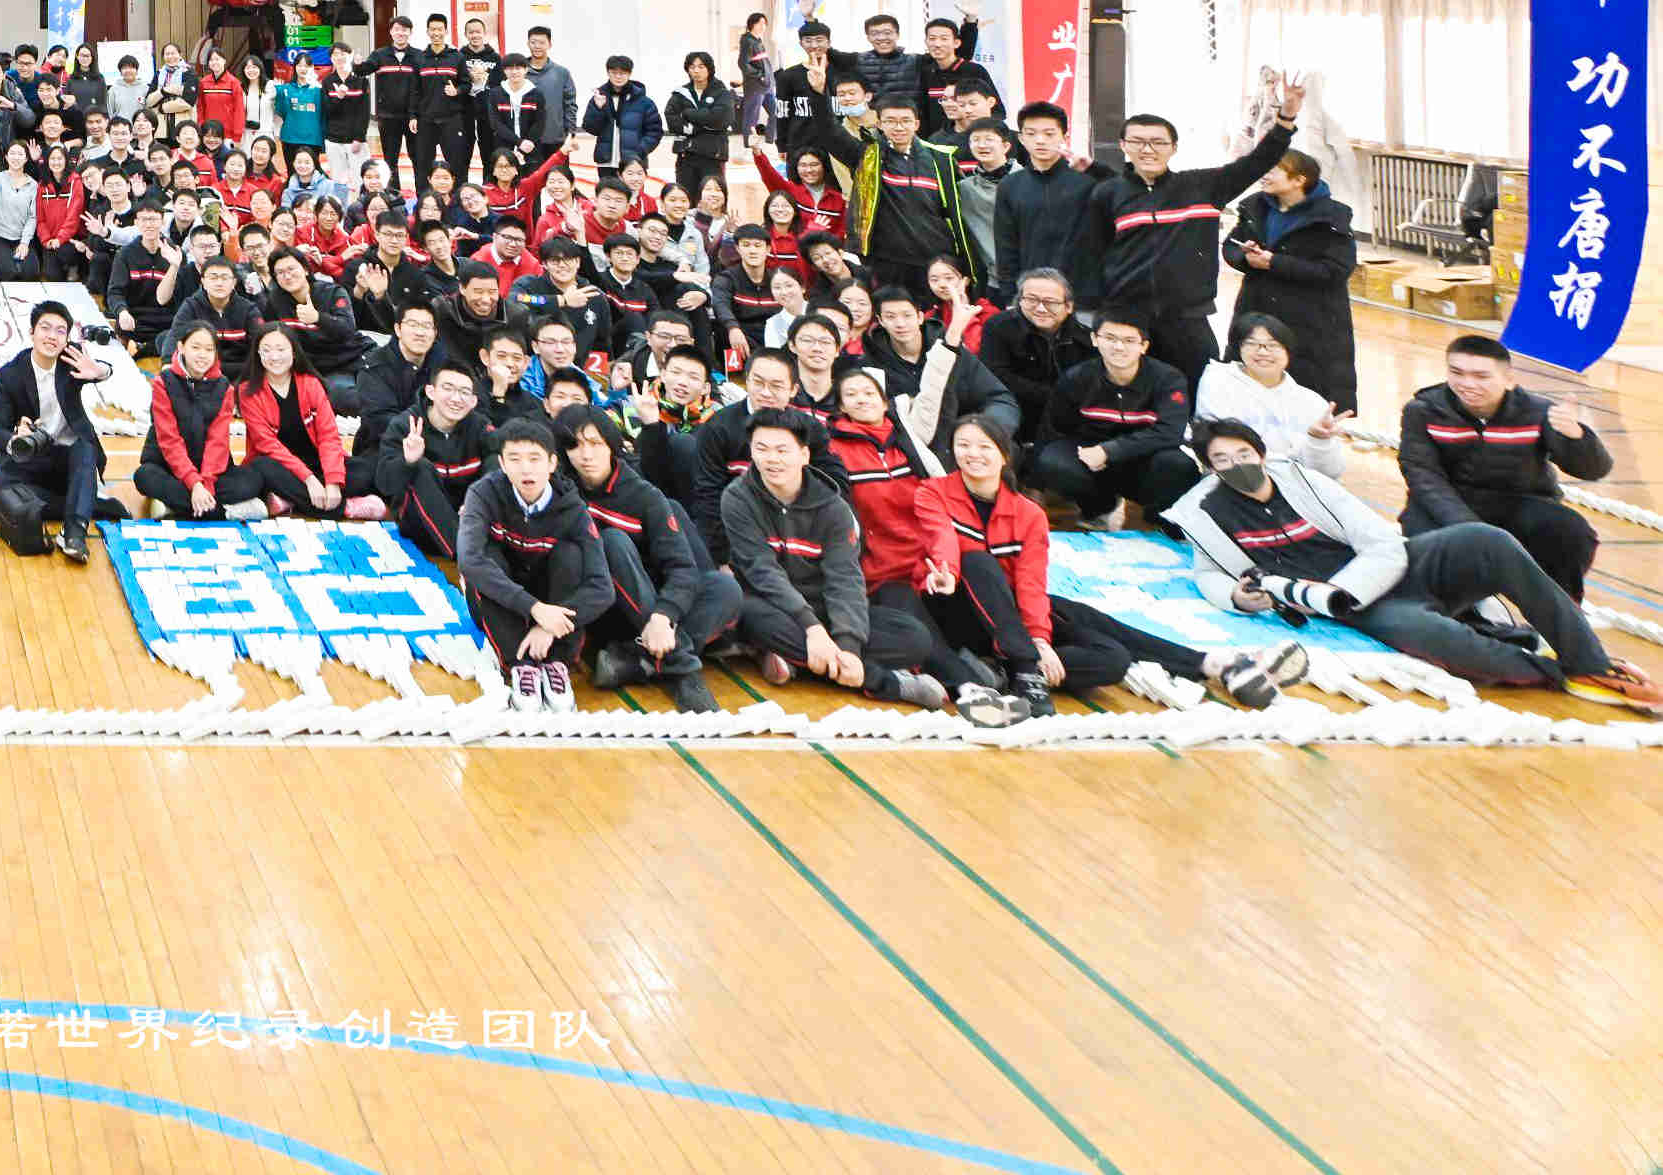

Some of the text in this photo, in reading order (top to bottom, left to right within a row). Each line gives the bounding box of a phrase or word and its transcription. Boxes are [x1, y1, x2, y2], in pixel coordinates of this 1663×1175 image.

[1548, 52, 1631, 332] 功不唐捐
[587, 353, 602, 373] 2
[727, 352, 739, 369] 4
